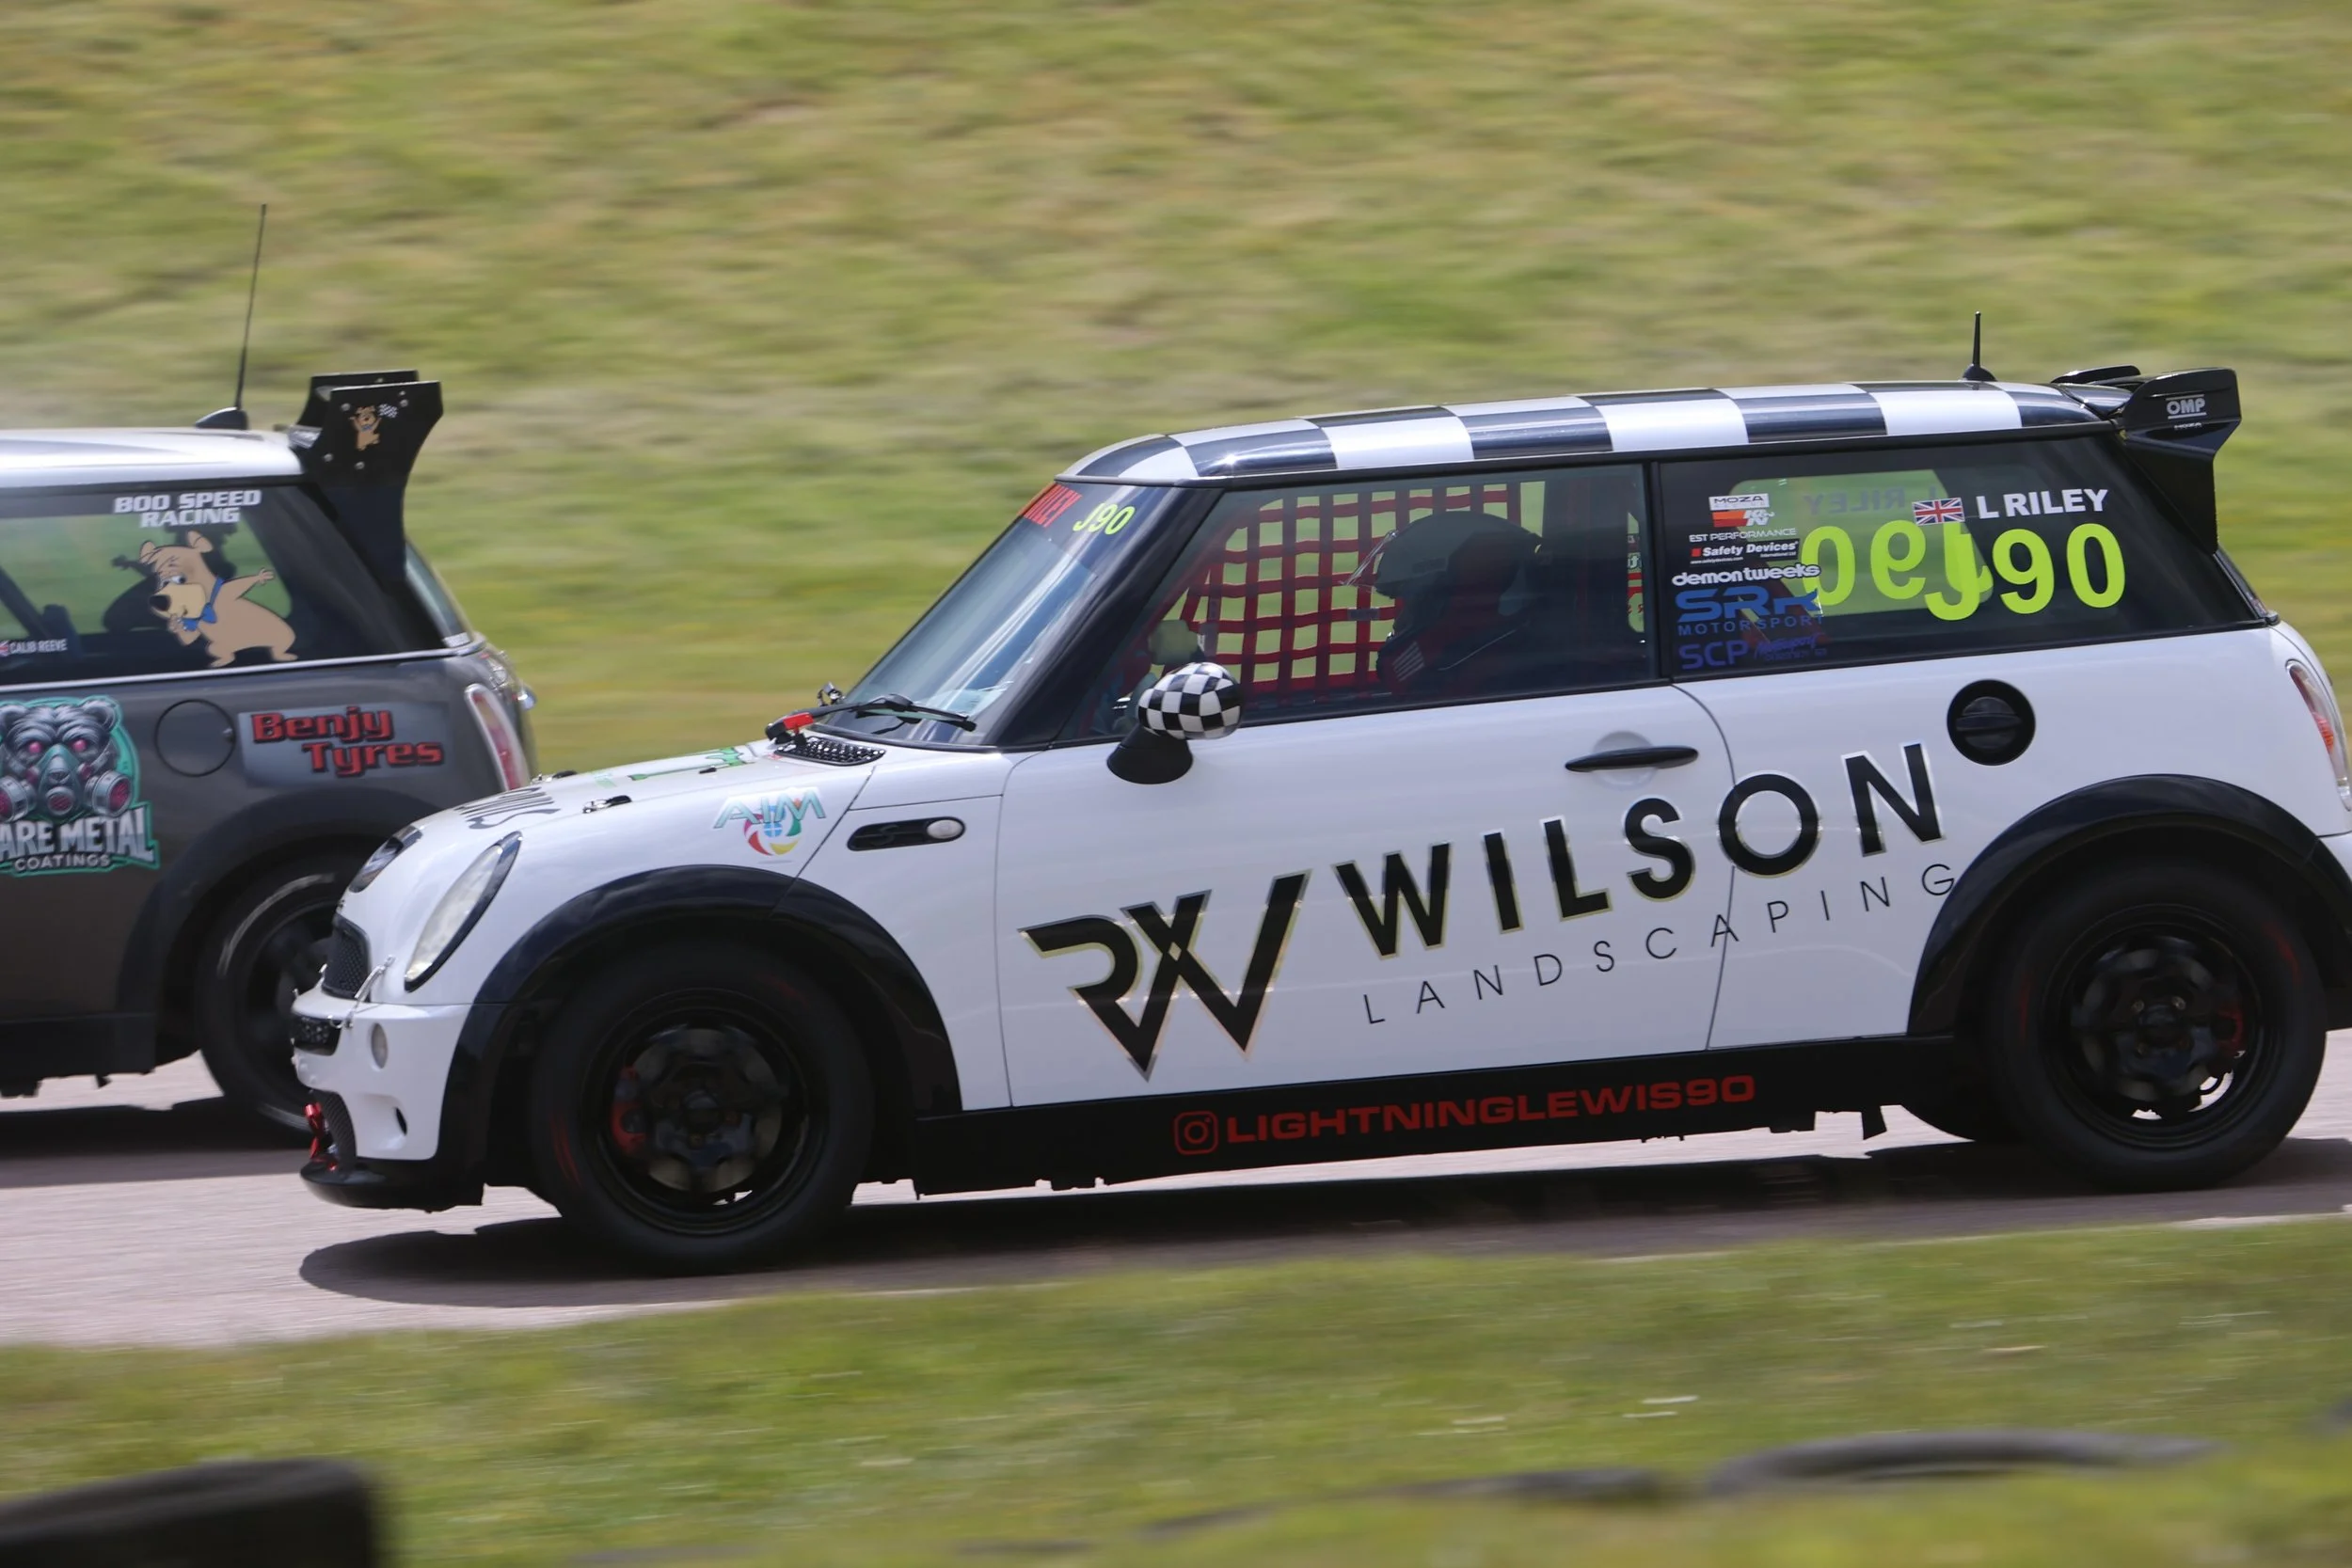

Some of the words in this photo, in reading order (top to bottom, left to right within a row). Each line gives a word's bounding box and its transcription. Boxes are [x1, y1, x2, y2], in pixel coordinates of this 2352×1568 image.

[2167, 397, 2206, 415] OMP
[114, 494, 171, 514] BOO
[179, 489, 262, 510] SPEED
[1714, 495, 1764, 504] MOZA
[1976, 495, 1999, 519] L
[2003, 488, 2108, 517] RILEY
[139, 507, 241, 528] RACING
[1073, 502, 1136, 535] J90
[1709, 528, 1797, 542] PERFORMANCE
[1702, 545, 1744, 557] Safety
[1925, 523, 2126, 621] J90
[1677, 614, 1824, 637] MOTORSPORT
[1678, 640, 1750, 670] SCP
[251, 706, 394, 743] Benjy
[301, 740, 445, 779] Tyres
[712, 789, 827, 830] AIM
[59, 806, 155, 863] METAL
[14, 853, 111, 872] COATINGS
[1333, 742, 1947, 961] WILSON
[1363, 863, 1956, 1025] LANDSCAPING
[1228, 1074, 1756, 1144] LIGHTNINGLEWIS90
